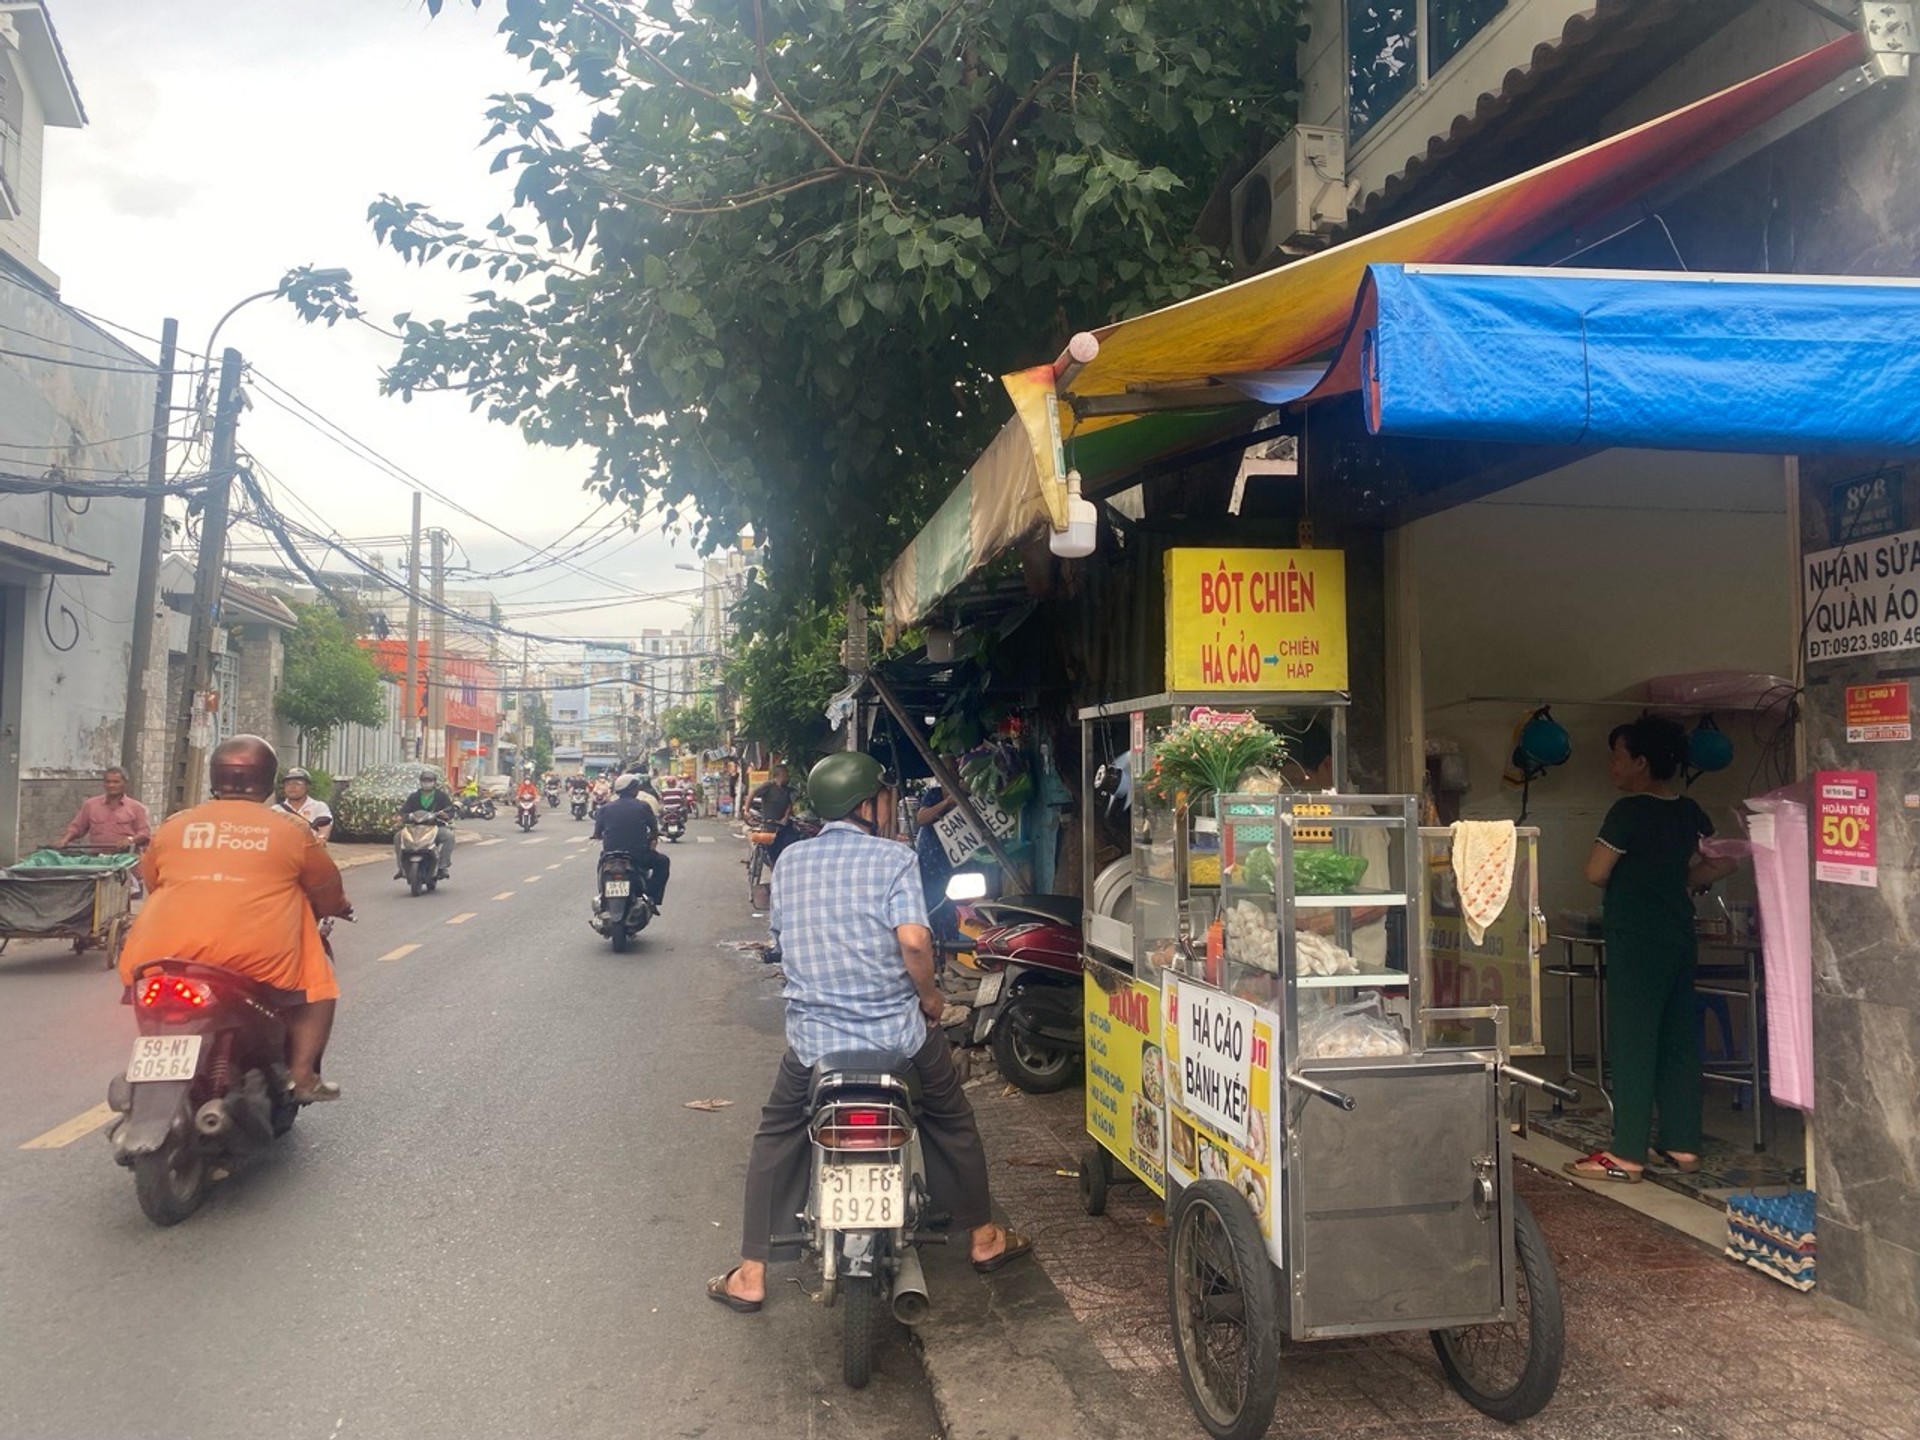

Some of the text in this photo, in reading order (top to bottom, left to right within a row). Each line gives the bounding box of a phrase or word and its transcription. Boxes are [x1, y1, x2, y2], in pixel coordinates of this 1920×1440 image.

[1809, 537, 1920, 592] NHẬN SỬA
[1201, 557, 1315, 626] BỘT CHIÊN
[1816, 584, 1918, 634] QUẦN ÁO
[1202, 630, 1261, 684] HÁ CẢO
[219, 820, 270, 837] Shopee
[1822, 802, 1848, 814] HOÀN
[216, 834, 269, 852] Food
[1822, 815, 1871, 848] 50%
[1192, 997, 1211, 1048] HÁ
[1213, 1006, 1243, 1062] CẢO
[132, 1058, 191, 1077] 605.64
[1185, 1052, 1220, 1112] BÁNH
[1223, 1073, 1248, 1126] XẾP
[832, 1196, 891, 1222] 6928
